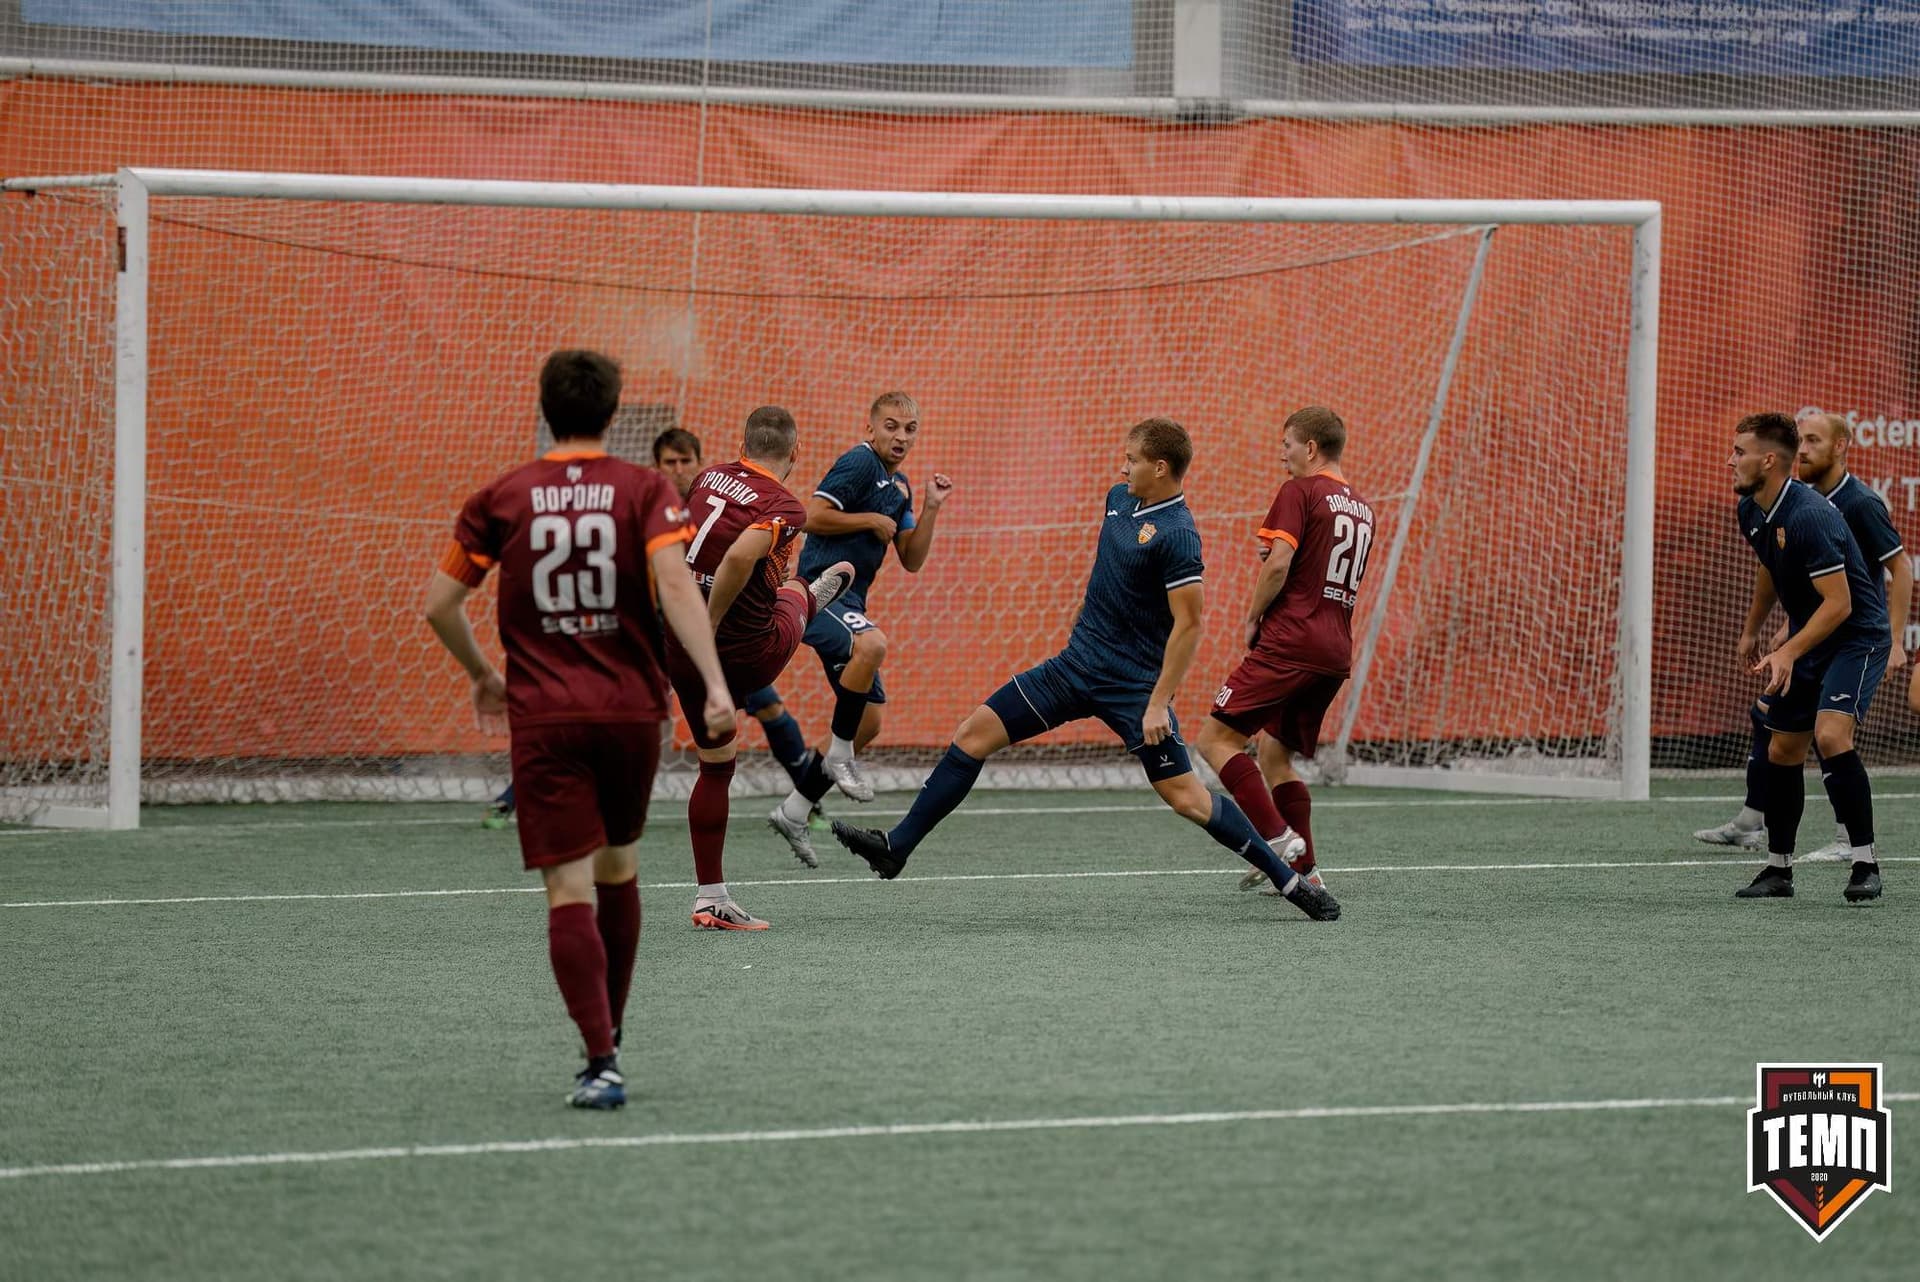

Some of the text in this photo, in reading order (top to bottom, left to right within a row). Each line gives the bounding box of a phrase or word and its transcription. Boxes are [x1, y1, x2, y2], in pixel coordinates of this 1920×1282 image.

[531, 484, 615, 513] ВОРОНА
[700, 471, 758, 505] ТРОЦЕНКО
[685, 495, 727, 564] 7
[1326, 515, 1371, 592] 20
[530, 513, 616, 613] 23
[1215, 685, 1233, 707] 20
